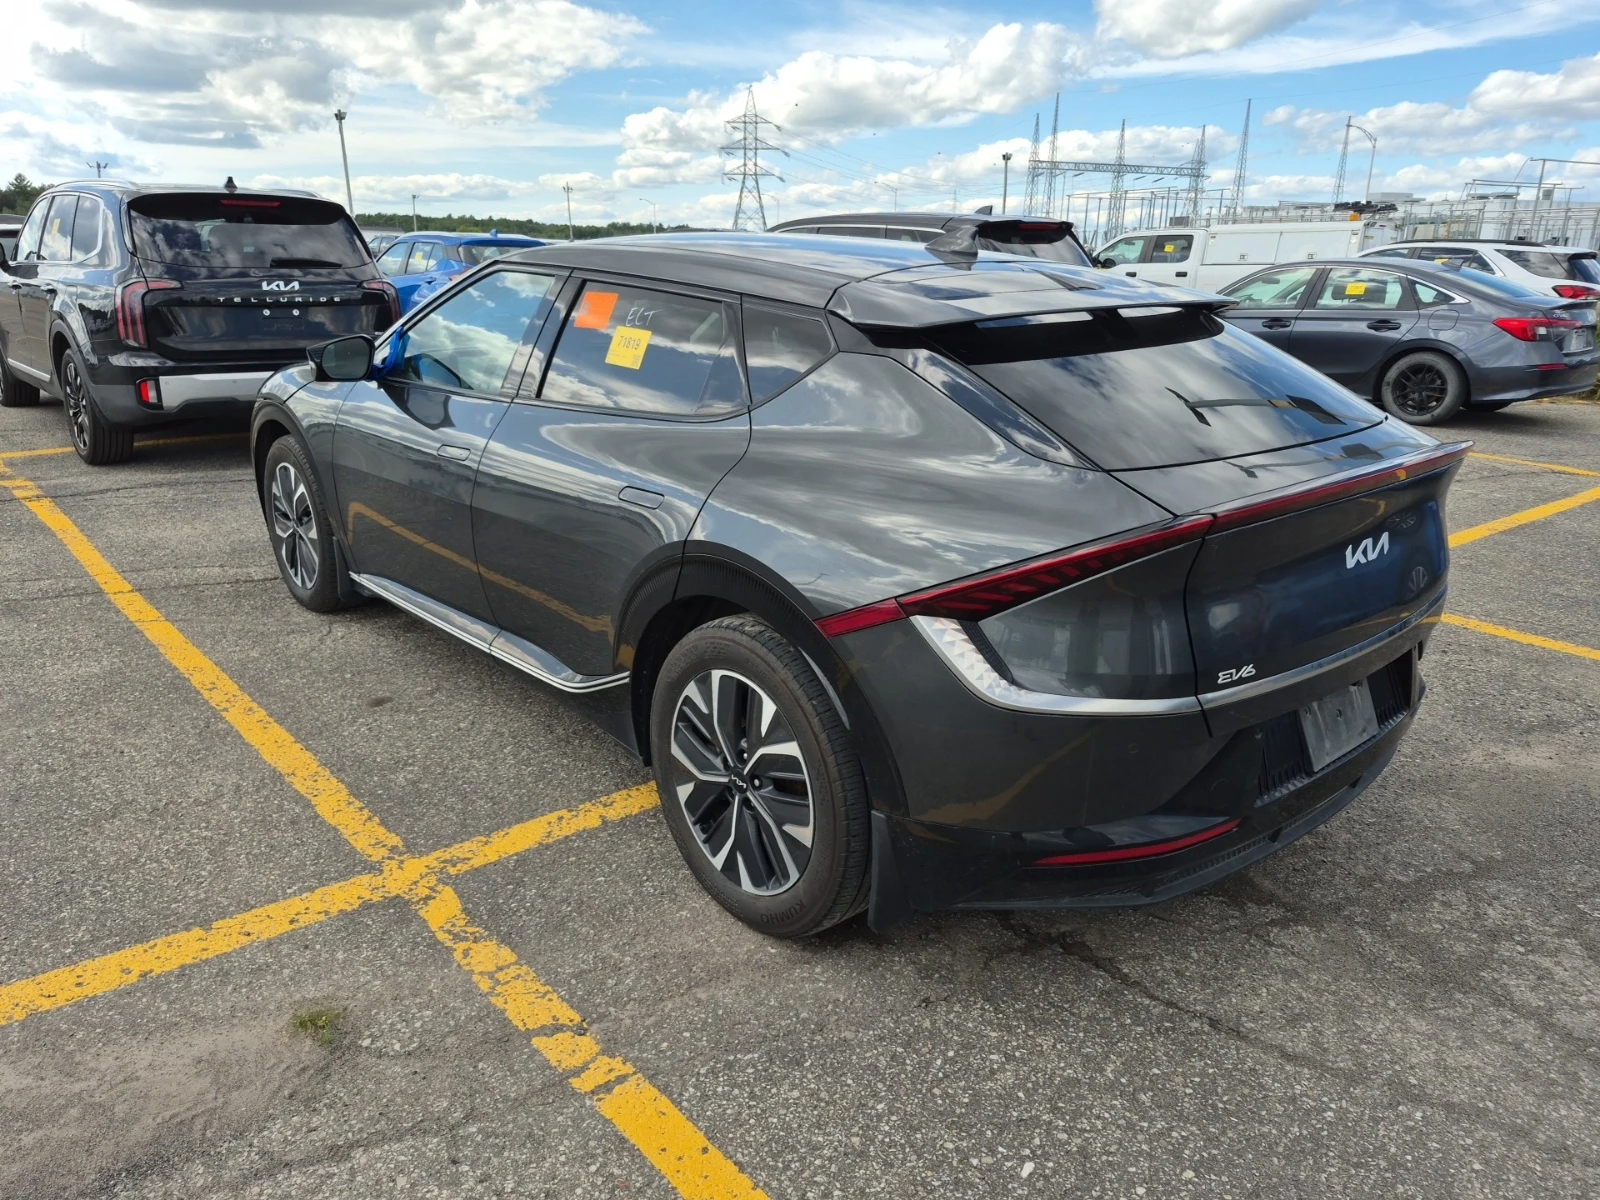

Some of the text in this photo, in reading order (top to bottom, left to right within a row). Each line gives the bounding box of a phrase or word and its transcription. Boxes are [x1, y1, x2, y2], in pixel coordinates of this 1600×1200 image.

[261, 280, 300, 291] KIA
[617, 335, 642, 350] 71819
[1345, 531, 1390, 570] KIA
[1217, 663, 1256, 685] EV6
[760, 899, 806, 924] KUMHO
